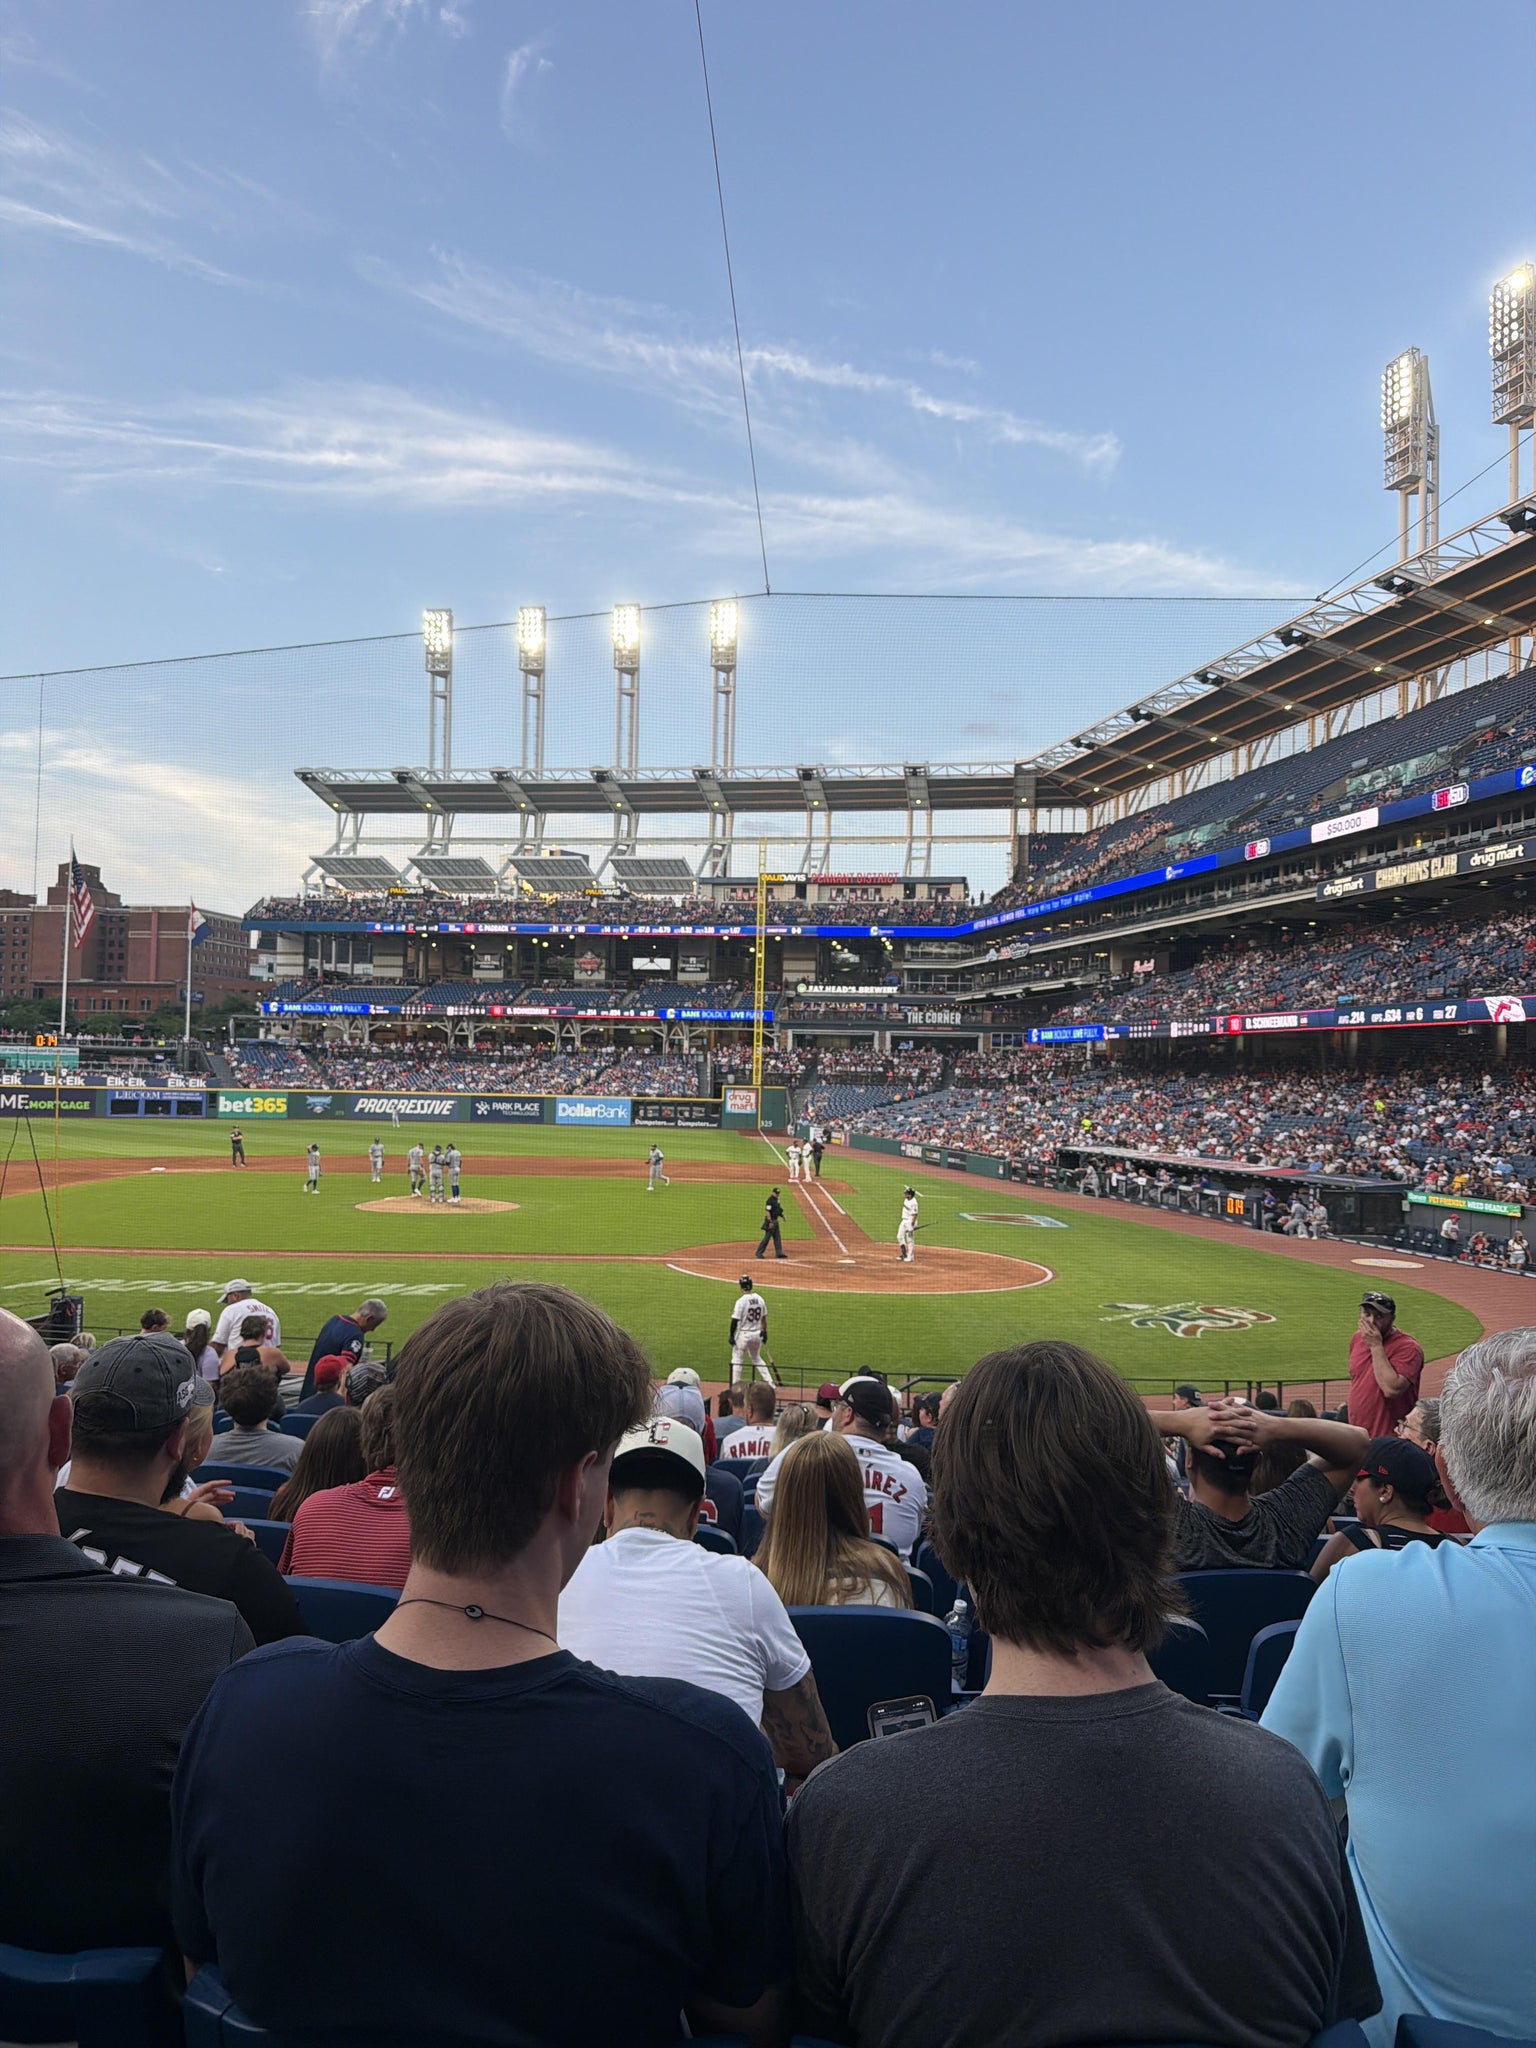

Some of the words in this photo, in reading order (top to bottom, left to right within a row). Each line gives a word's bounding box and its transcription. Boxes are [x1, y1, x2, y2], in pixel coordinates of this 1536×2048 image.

[856, 873, 899, 884] DISTRICT
[1376, 861, 1429, 889] CHAMPIONS
[1431, 854, 1457, 878] CLUB
[907, 1012, 923, 1024] THE
[925, 1012, 961, 1024] CORNER
[1445, 1005, 1457, 1019] 27
[115, 1091, 160, 1099] LECOM
[729, 1090, 751, 1103] drug
[219, 1096, 287, 1113] bet365
[354, 1098, 457, 1115] PROGRESSIVE
[492, 1102, 513, 1111] PARK
[514, 1103, 540, 1112] PLACE
[748, 1307, 761, 1322] 38
[730, 1436, 770, 1458] RAMÍR
[865, 1463, 908, 1503] ÍREZ
